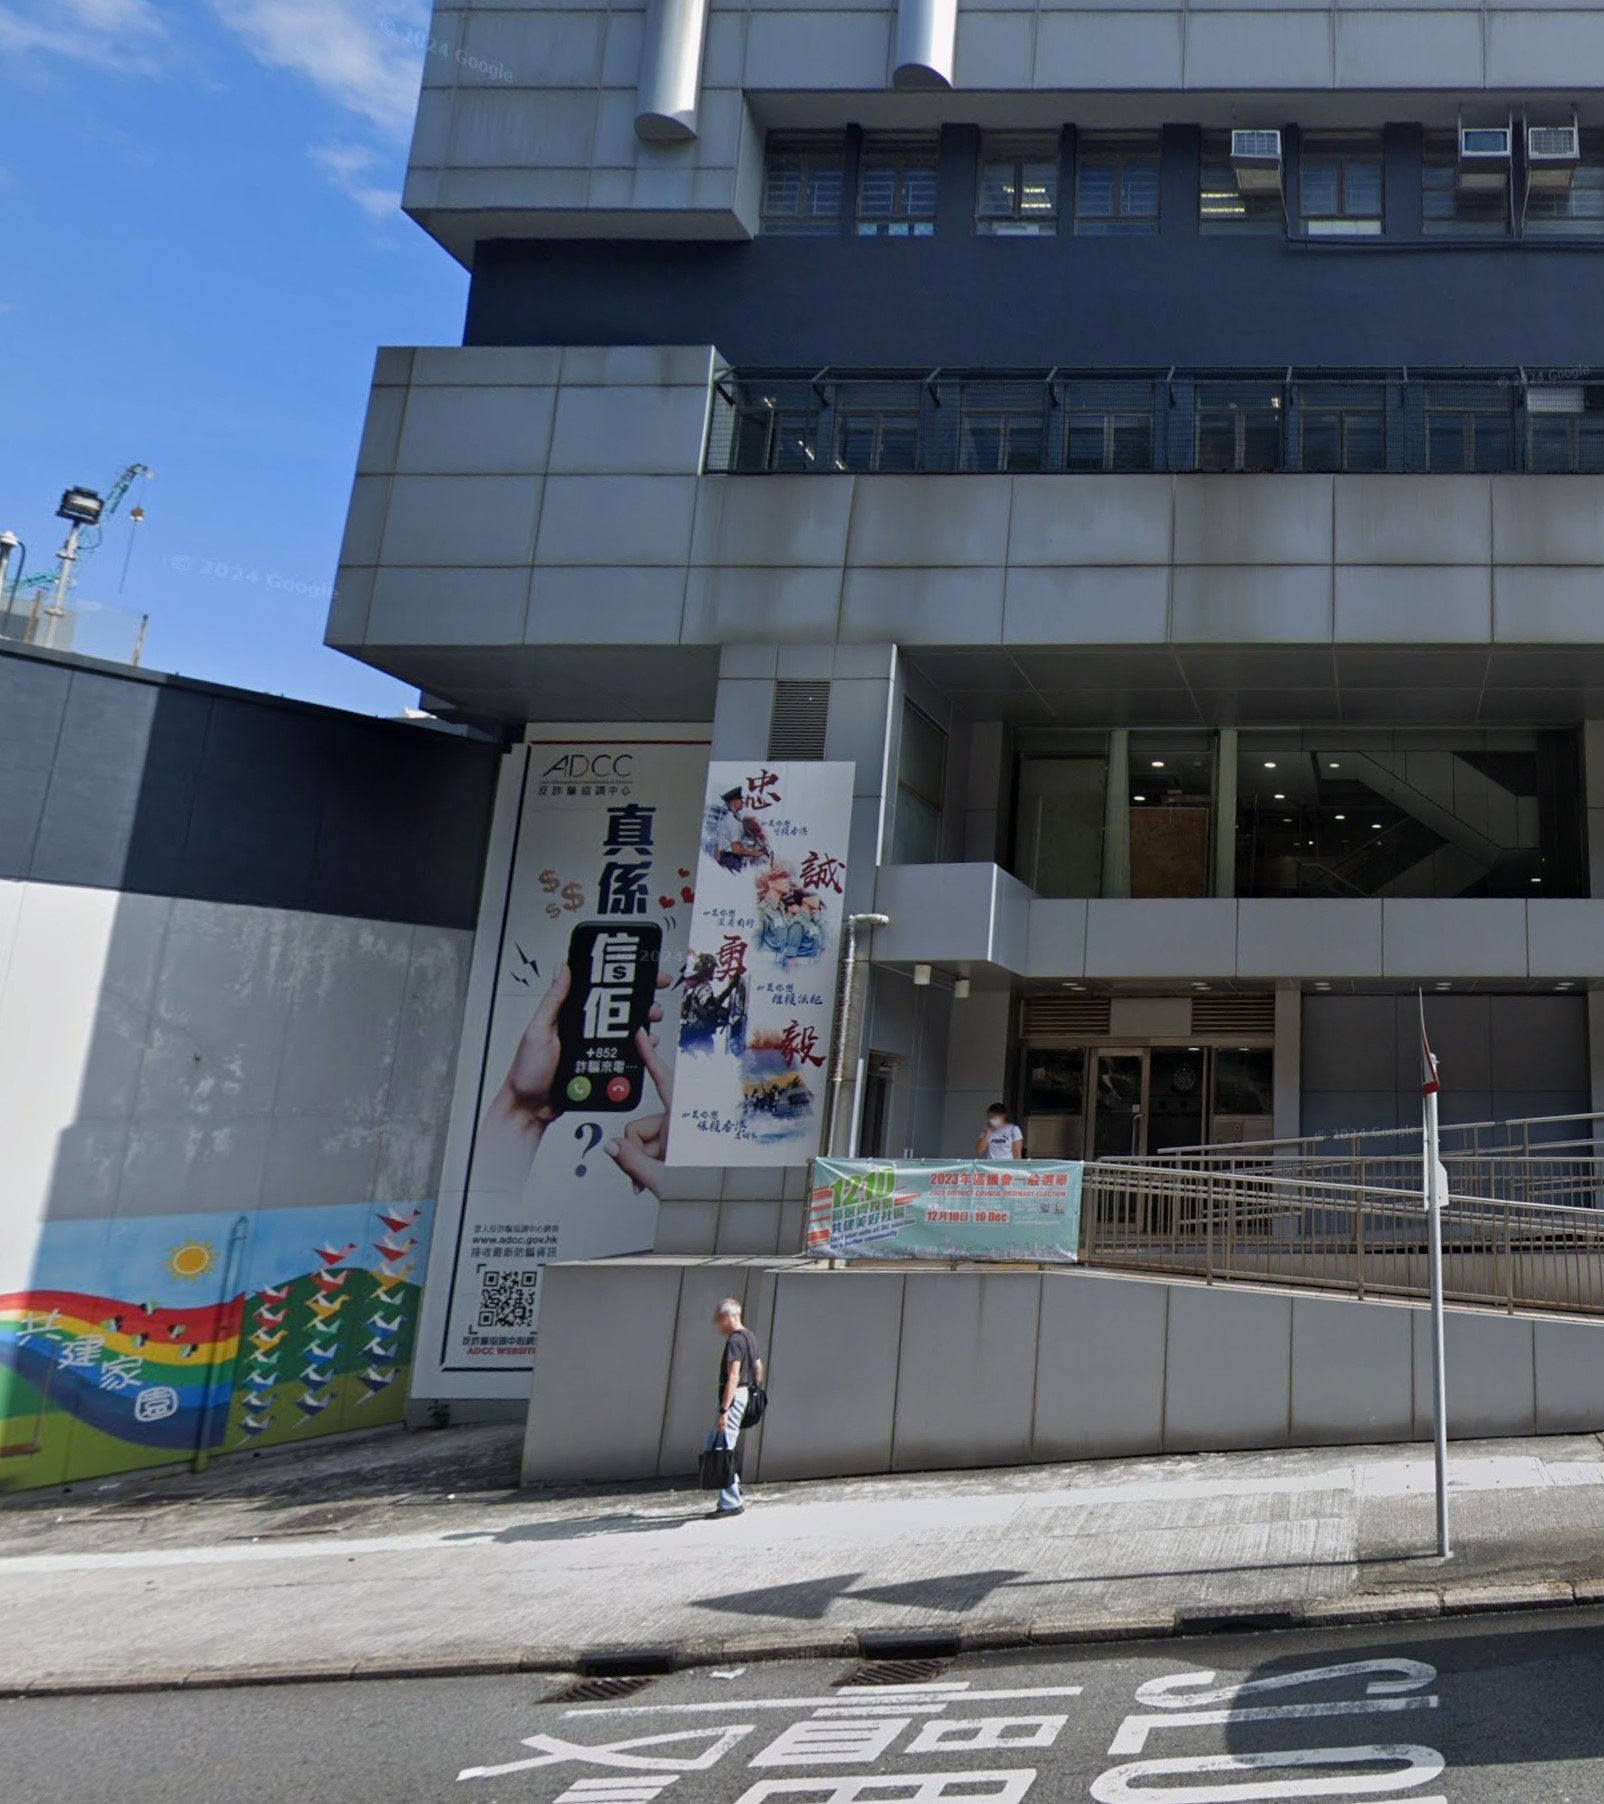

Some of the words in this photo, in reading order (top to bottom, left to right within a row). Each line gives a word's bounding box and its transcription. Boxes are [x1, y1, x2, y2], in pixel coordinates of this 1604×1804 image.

[542, 754, 633, 777] ADCC
[538, 785, 632, 796] 反詐騙協調中心
[743, 769, 782, 811] 忠
[800, 850, 846, 895] 誠
[715, 934, 748, 982] 勇
[780, 1019, 828, 1068] 毅
[586, 1047, 618, 1059] +852
[930, 1172, 1068, 1187] 2023年區議會一般選舉
[831, 1168, 896, 1209] 1210
[946, 1189, 974, 1198] DISTRICT
[975, 1189, 1002, 1198] COUNCIL
[1003, 1189, 1035, 1198] ORDINARY
[1036, 1190, 1067, 1198] ELECTION
[926, 1210, 969, 1222] 12月10日
[975, 1210, 987, 1222] 10
[988, 1211, 1008, 1222] Dec
[472, 1235, 559, 1245] www.adcc.gov.hk
[470, 1247, 558, 1259] 接收最新防騙資訊
[462, 1336, 539, 1347] 反詐騙協調中心網
[466, 1347, 495, 1356] ADCC
[1089, 1656, 1447, 1804] SLO
